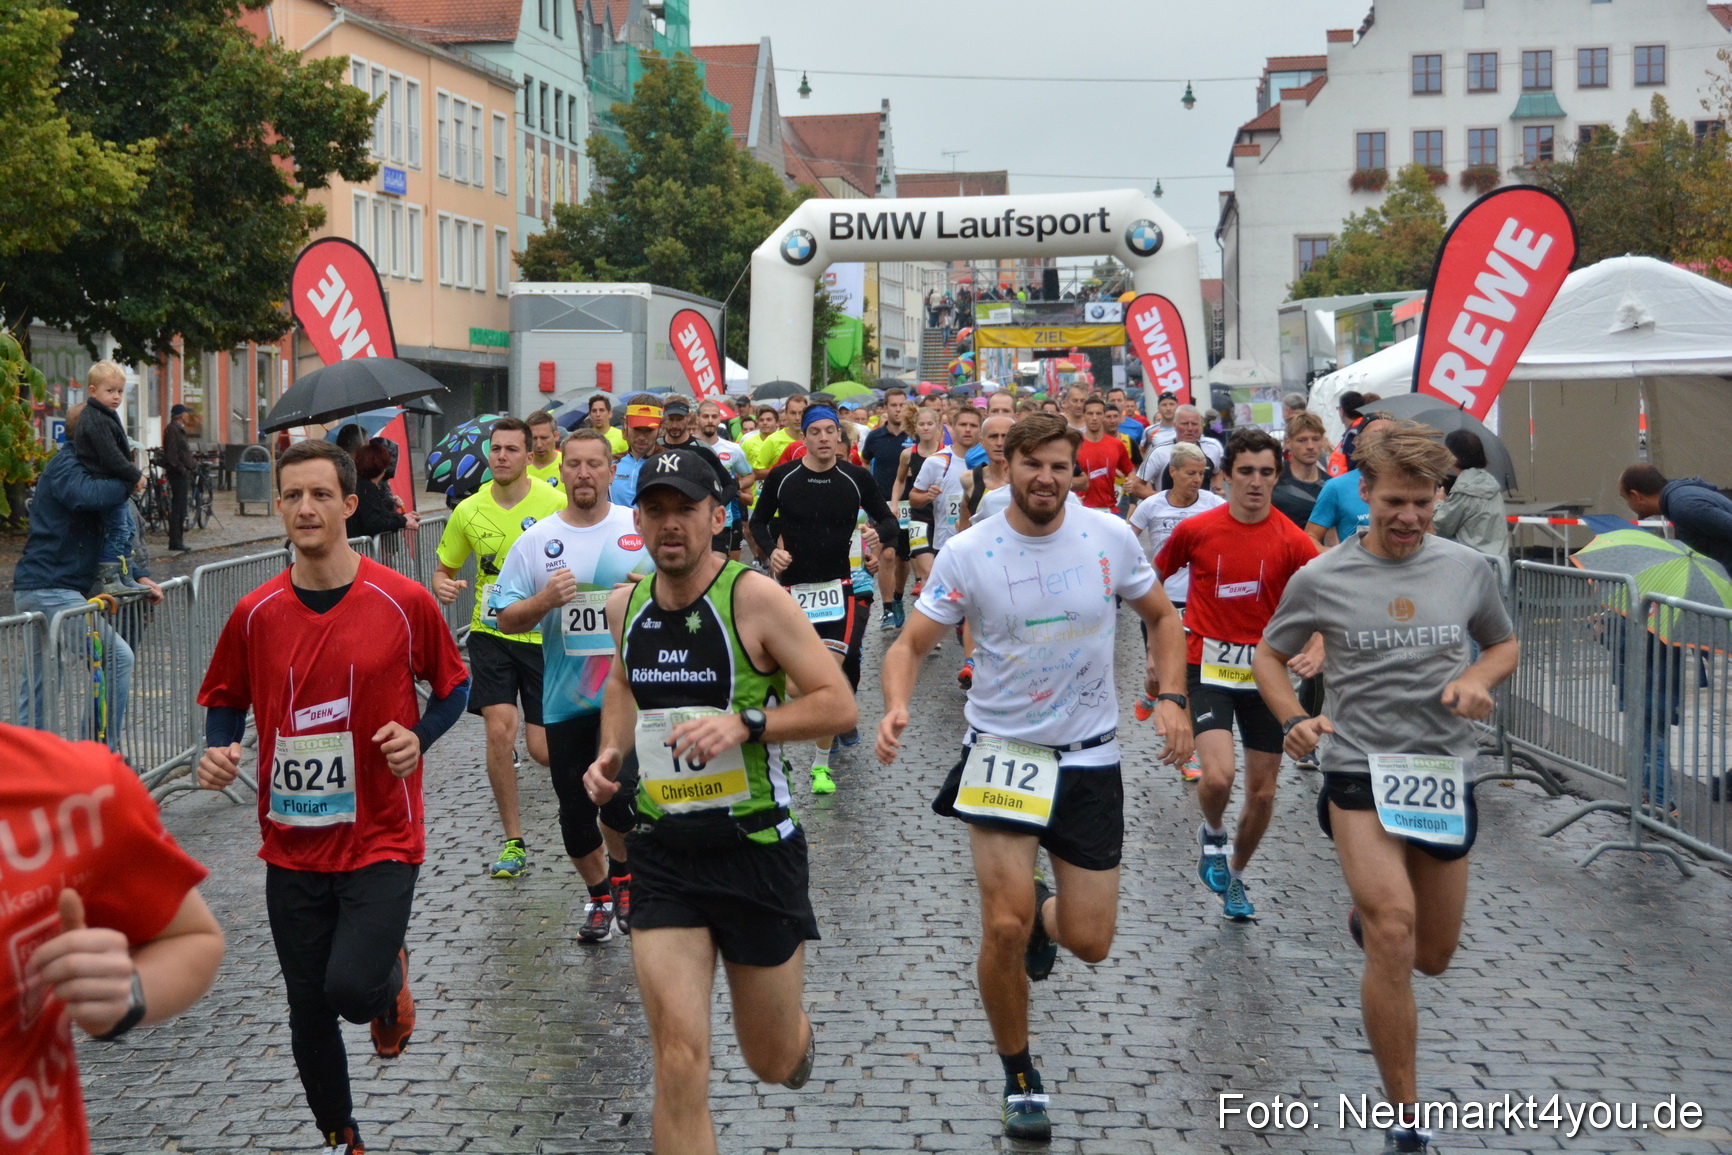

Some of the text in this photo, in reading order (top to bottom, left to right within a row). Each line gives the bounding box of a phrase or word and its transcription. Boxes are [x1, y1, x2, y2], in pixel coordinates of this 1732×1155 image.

[829, 207, 1111, 242] BMW Laufsport
[1429, 216, 1554, 410] REWE
[1034, 331, 1068, 343] ZIEL
[55, 424, 65, 440] P
[545, 559, 567, 569] PARTL
[1002, 560, 1084, 605] Herr
[1229, 586, 1247, 594] DEHN
[797, 589, 839, 609] 2790
[807, 610, 833, 618] Thomas
[1344, 624, 1461, 650] LEHMEIER
[658, 649, 689, 663] DAV
[1391, 652, 1407, 660] und
[631, 667, 718, 683] Röthenbach
[310, 707, 333, 721] DEHN
[293, 737, 344, 751] BOCK
[1007, 742, 1053, 761] BOCK
[1413, 758, 1456, 771] BOCK
[982, 754, 1039, 792] 112
[661, 780, 723, 800] Christian
[1382, 774, 1456, 810] 2228
[283, 799, 328, 813] Florian
[982, 791, 1024, 809] Fabian
[1394, 813, 1448, 832] Christoph
